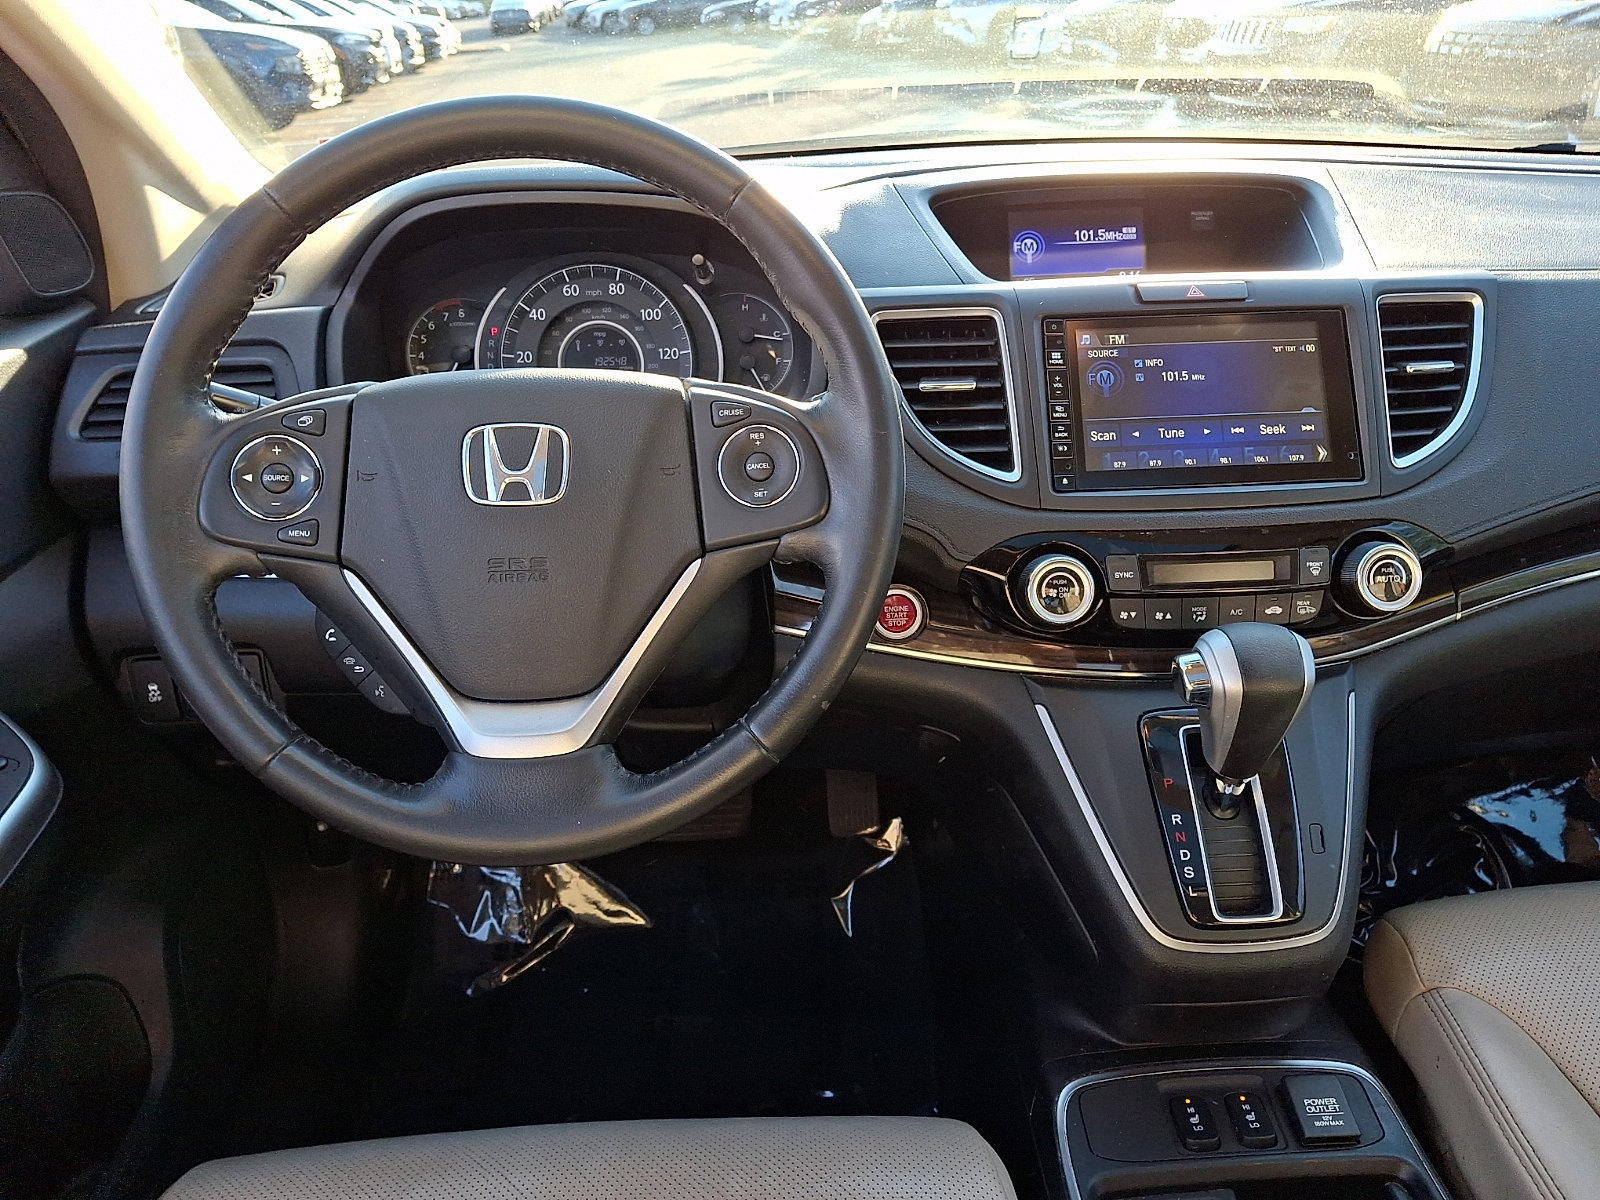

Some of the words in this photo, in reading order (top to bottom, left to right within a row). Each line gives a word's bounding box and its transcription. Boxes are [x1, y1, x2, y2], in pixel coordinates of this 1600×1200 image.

[1074, 229, 1106, 241] 101.5
[1105, 231, 1123, 240] MHz
[562, 284, 580, 297] 60
[585, 289, 602, 297] mph
[608, 283, 625, 296] 80
[443, 312, 449, 322] 7
[529, 308, 546, 321] 40
[640, 308, 662, 321] 100
[428, 321, 436, 331] 6
[491, 327, 499, 336] P
[420, 334, 428, 344] 5
[1109, 334, 1126, 345] FM
[1087, 349, 1119, 358] SOURCE
[1305, 344, 1316, 353] 00
[417, 351, 425, 361] 4
[516, 351, 533, 364] 20
[658, 348, 679, 360] 120
[595, 357, 627, 366] 192548
[1144, 358, 1164, 367] INFO
[1161, 370, 1189, 382] 101.5
[718, 408, 745, 417] CRUISE
[1158, 427, 1185, 439] Tune
[1259, 423, 1287, 435] Seek
[749, 432, 765, 440] RES
[1090, 430, 1117, 442] Scan
[1149, 459, 1162, 467] 87.9
[1288, 454, 1304, 462] 107.9
[746, 462, 771, 471] CANCEL
[263, 474, 290, 482] SOURCE
[753, 490, 769, 498] SET
[288, 529, 311, 537] MENU
[487, 556, 548, 569] SRS
[487, 572, 550, 583] AIRBAG
[1114, 571, 1134, 579] SYNC
[884, 605, 909, 613] ENGINE
[1230, 608, 1243, 616] A/C
[886, 611, 908, 619] START
[1163, 778, 1174, 789] P
[1171, 814, 1183, 825] R
[1175, 831, 1187, 842] N
[1179, 849, 1191, 861] D
[1183, 866, 1195, 878] S
[1188, 885, 1198, 897] L
[1303, 1097, 1338, 1106] POWER
[1241, 1103, 1251, 1111] HI
[1305, 1104, 1340, 1113] OUTLET
